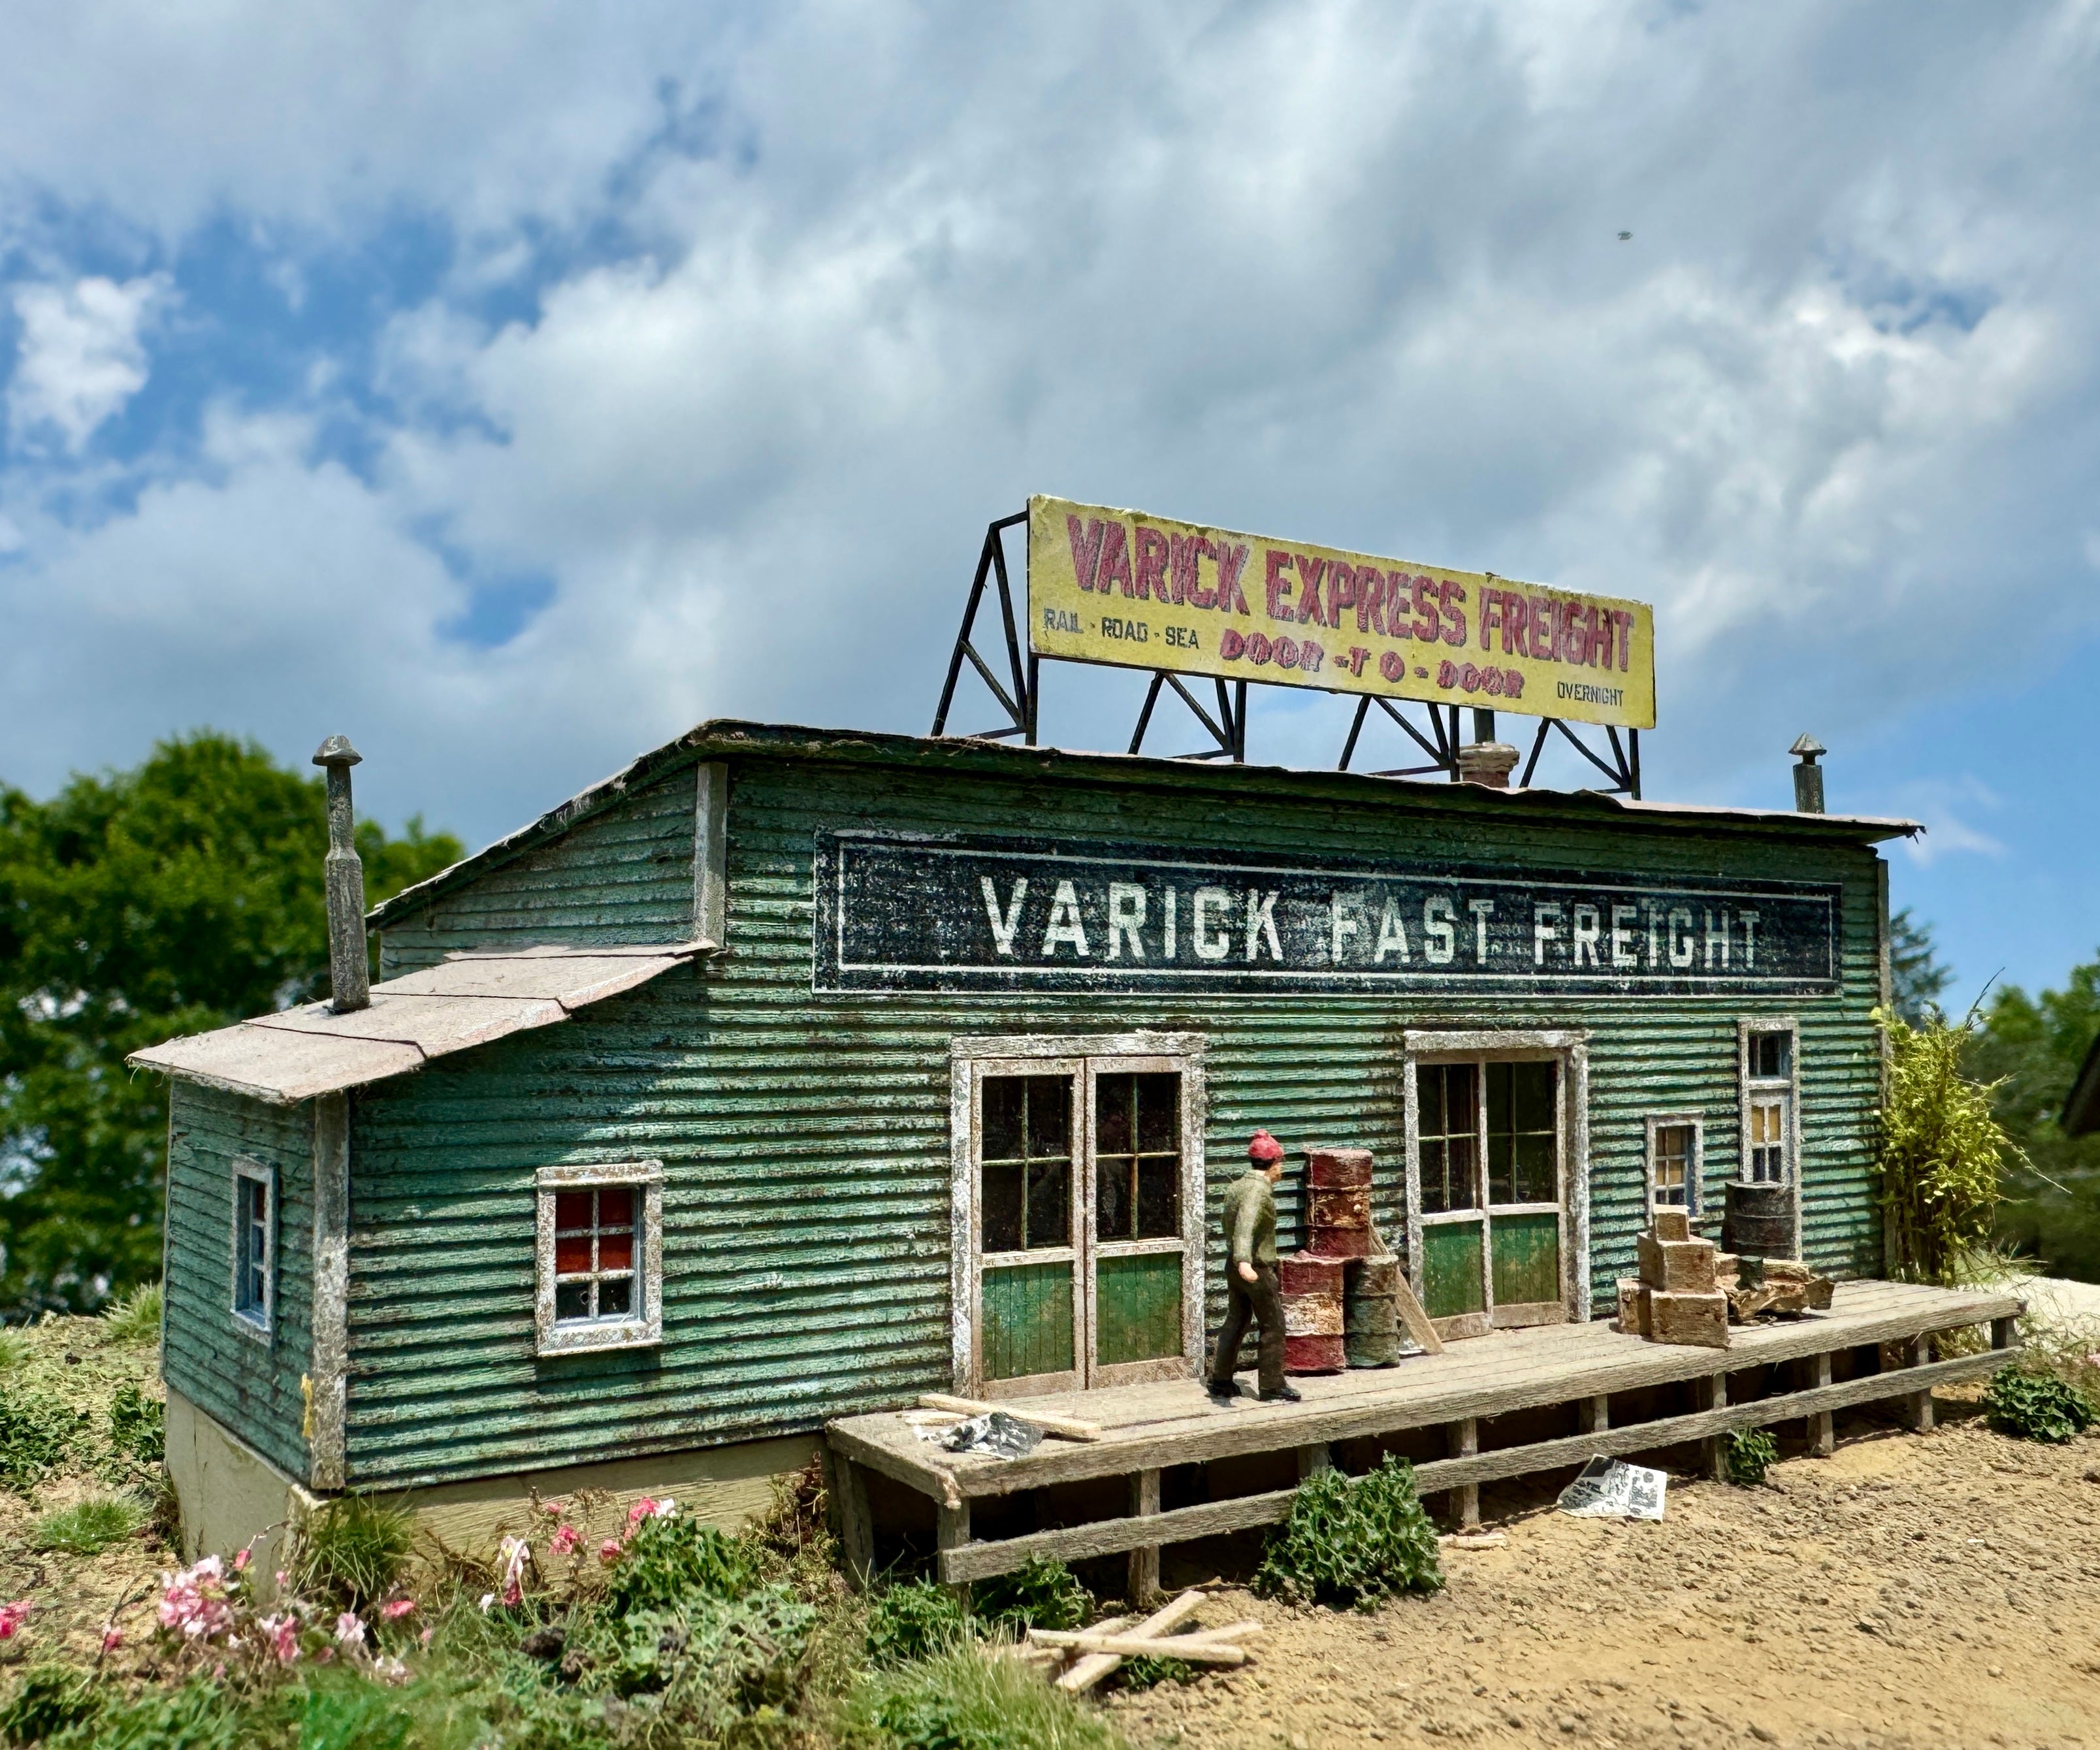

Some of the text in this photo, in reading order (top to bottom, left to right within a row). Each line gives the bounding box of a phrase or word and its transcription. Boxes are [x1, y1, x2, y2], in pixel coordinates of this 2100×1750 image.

[1067, 513, 1634, 673] VARICK EXPRESS FREIGHT
[1044, 608, 1200, 649] RAIL ROAD SEA
[1557, 681, 1624, 707] OVERNIGHT
[980, 875, 1760, 969] VARICK FAST FREIGHT
